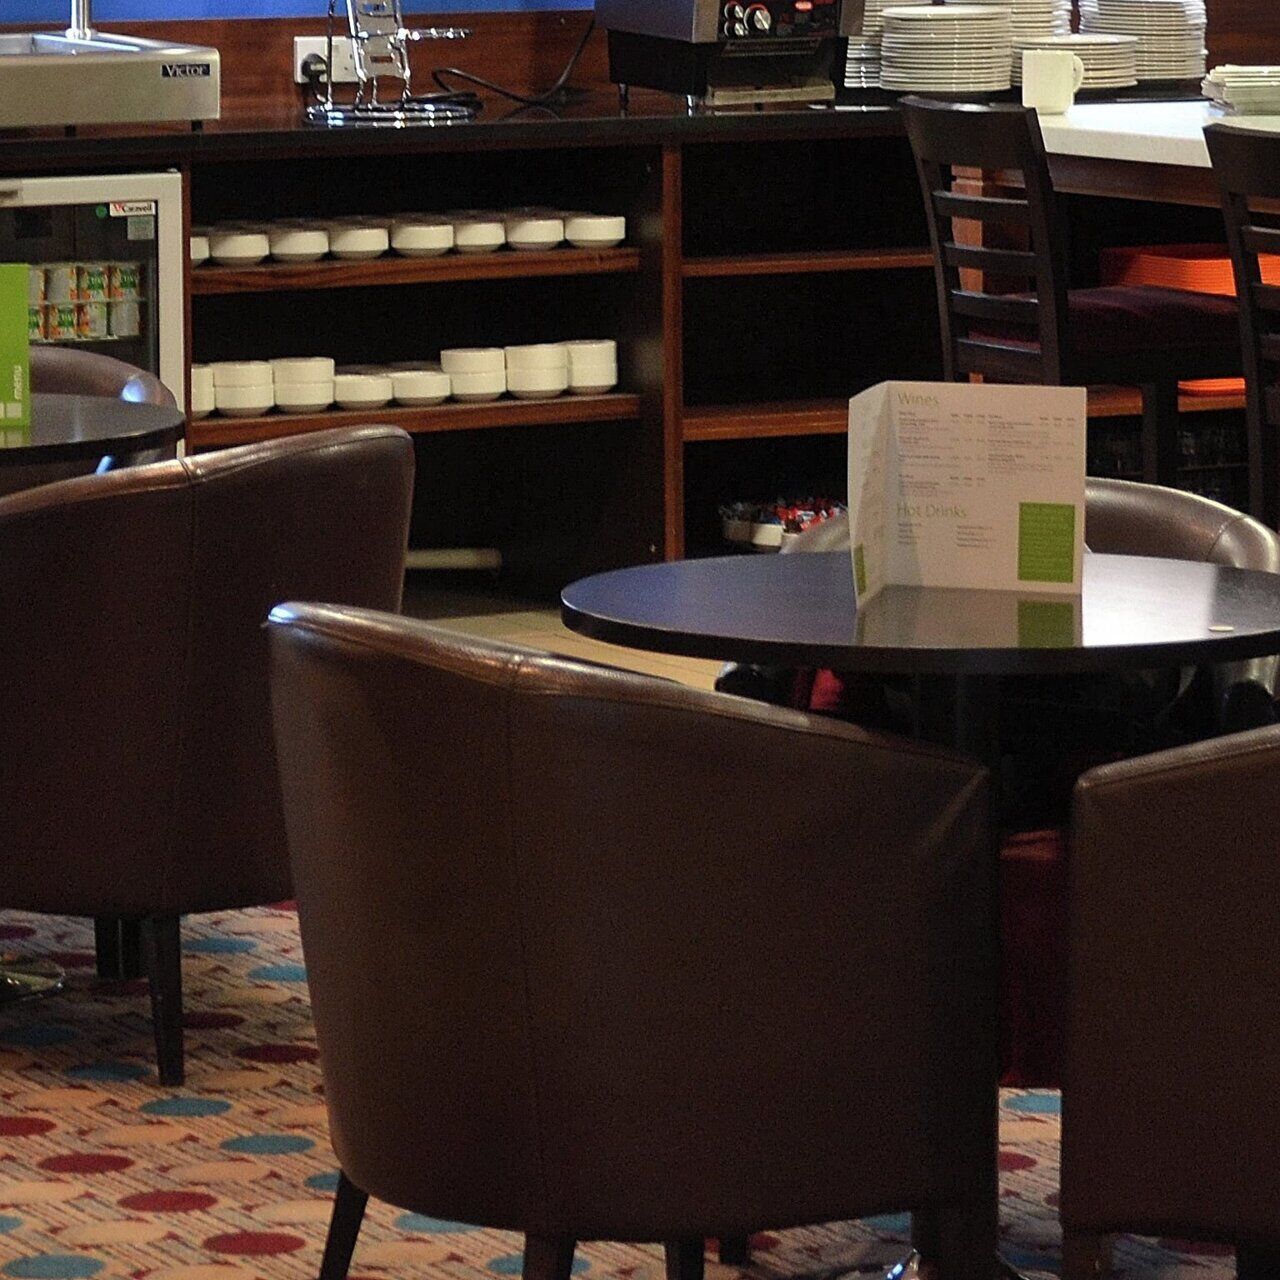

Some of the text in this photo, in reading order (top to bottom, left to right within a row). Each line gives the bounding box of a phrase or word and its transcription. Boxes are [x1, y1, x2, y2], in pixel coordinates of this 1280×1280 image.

[165, 64, 204, 77] Victor
[13, 365, 23, 400] menu
[898, 391, 939, 406] Wines
[896, 502, 966, 518] Hot Drinks
